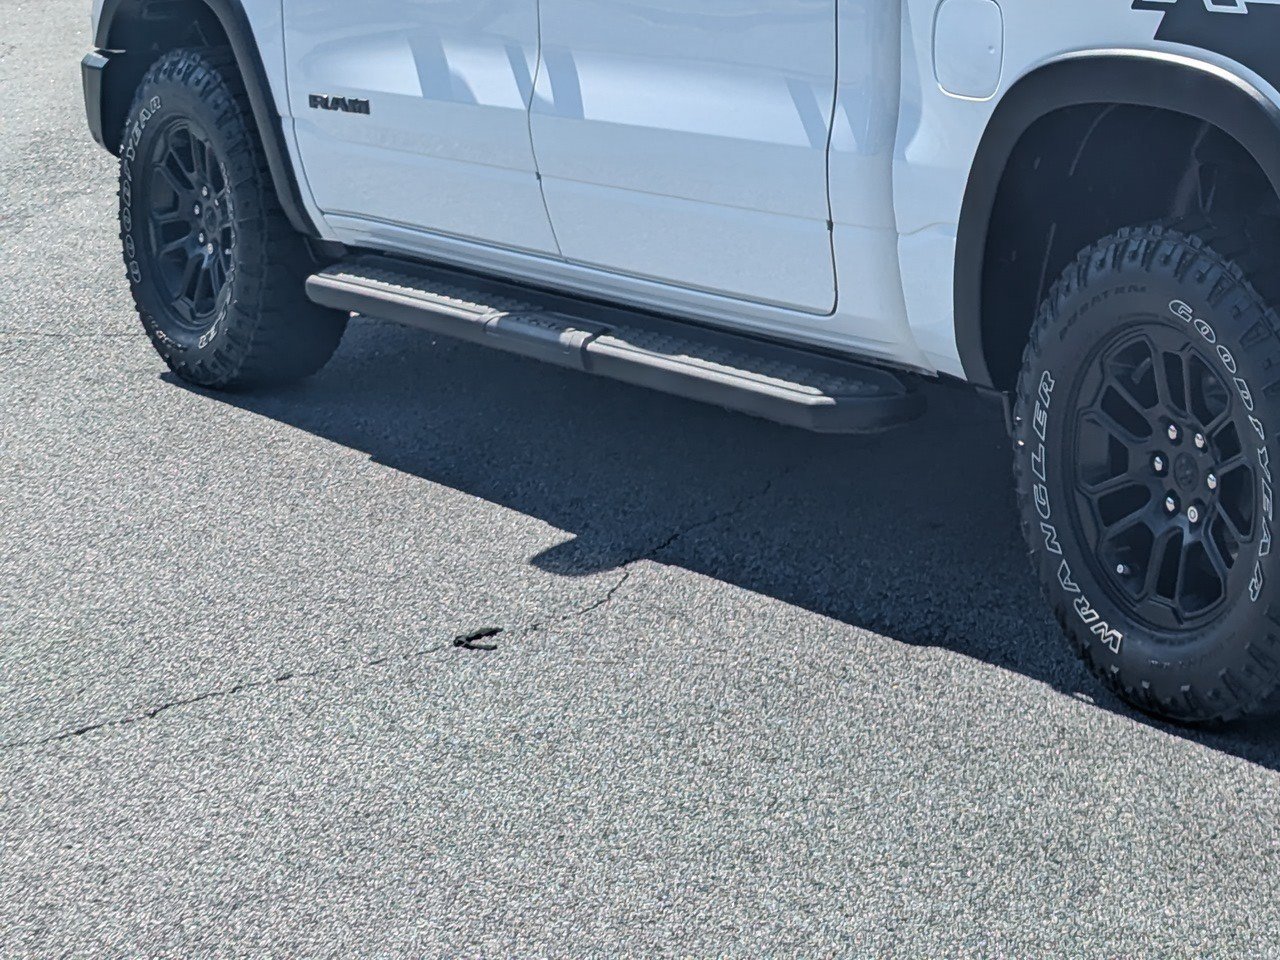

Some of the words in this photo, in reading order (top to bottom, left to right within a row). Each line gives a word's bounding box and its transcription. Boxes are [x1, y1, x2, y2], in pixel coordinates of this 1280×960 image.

[308, 94, 371, 115] RAM
[1030, 369, 1124, 655] WRANGLER
[1168, 299, 1274, 602] GOODYEAR
